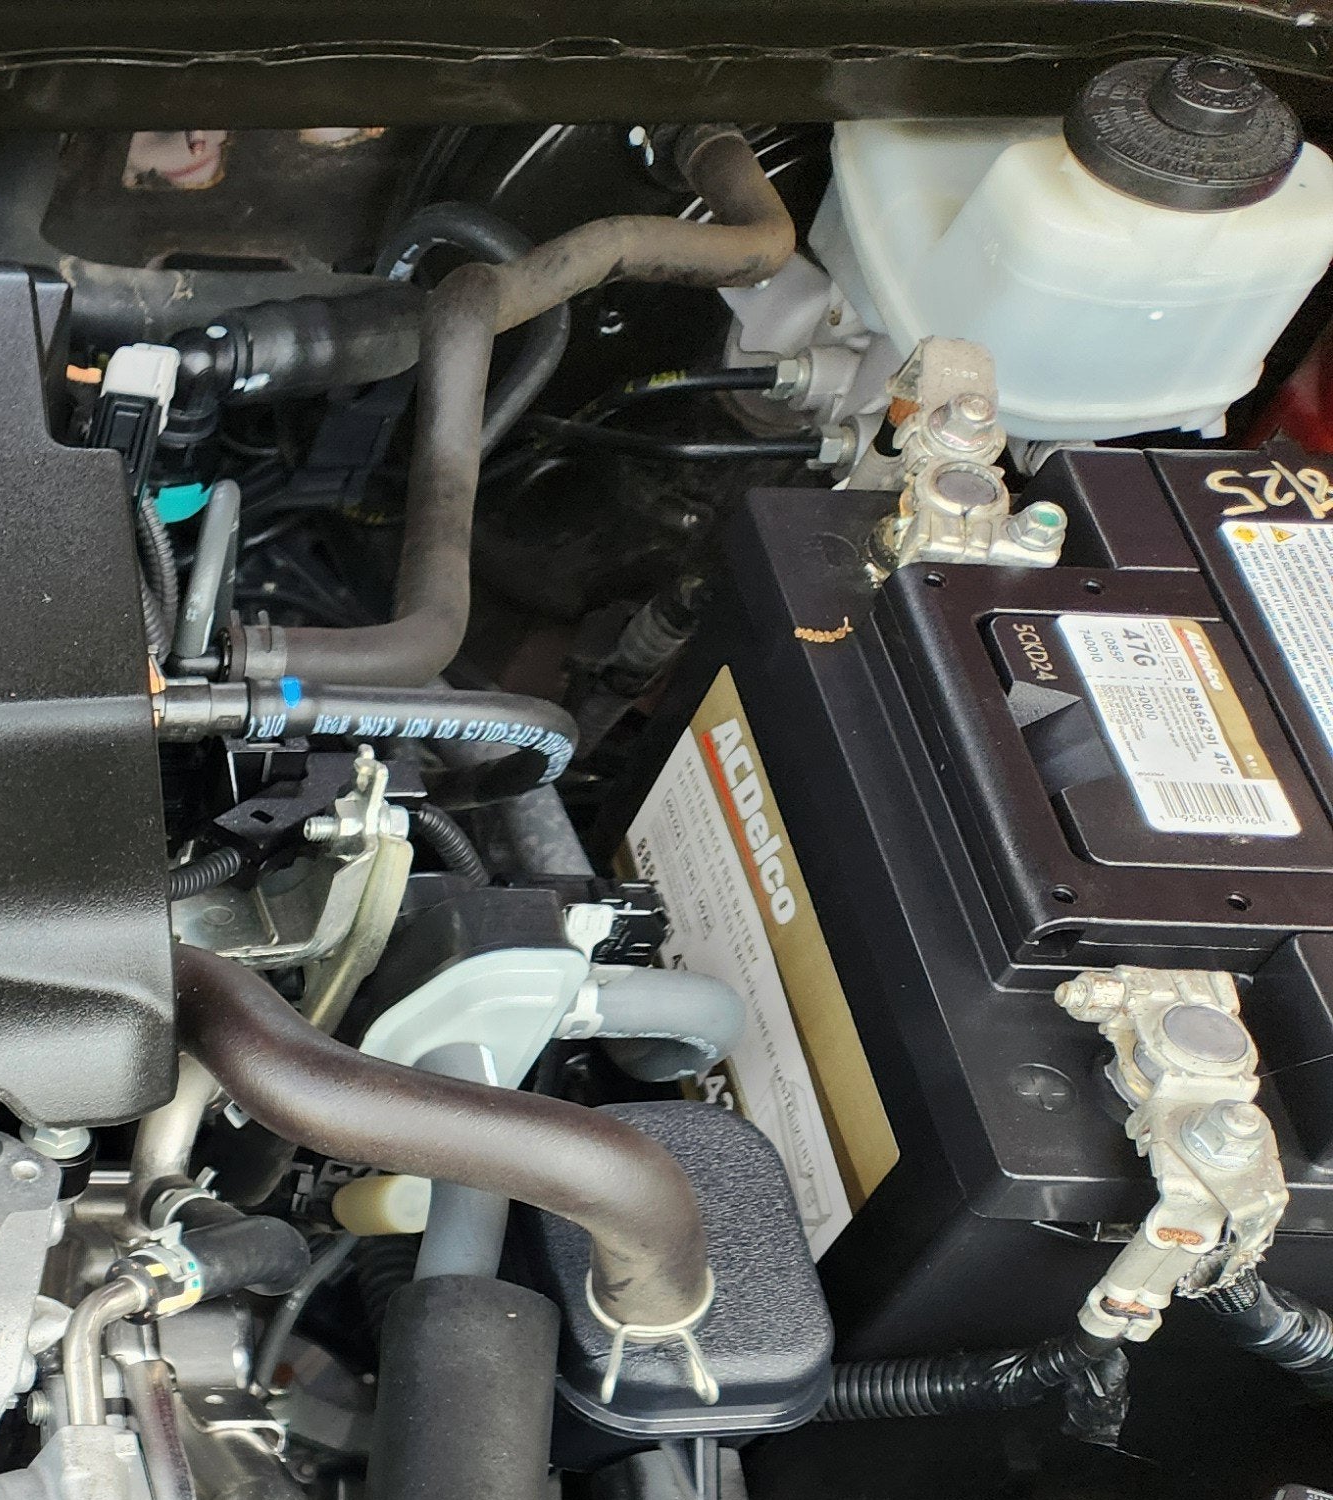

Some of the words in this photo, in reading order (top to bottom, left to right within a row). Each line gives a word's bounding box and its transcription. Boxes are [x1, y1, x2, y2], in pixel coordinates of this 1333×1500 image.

[1013, 623, 1059, 682] 5CKD24
[1078, 629, 1103, 663] 740010
[1122, 628, 1157, 667] 47G
[1133, 685, 1158, 721] 740010
[353, 716, 397, 737] KINK
[398, 718, 431, 738] NOT
[1182, 686, 1219, 745] 88866291
[1213, 751, 1234, 776] 47G
[710, 718, 796, 925] ACDelco
